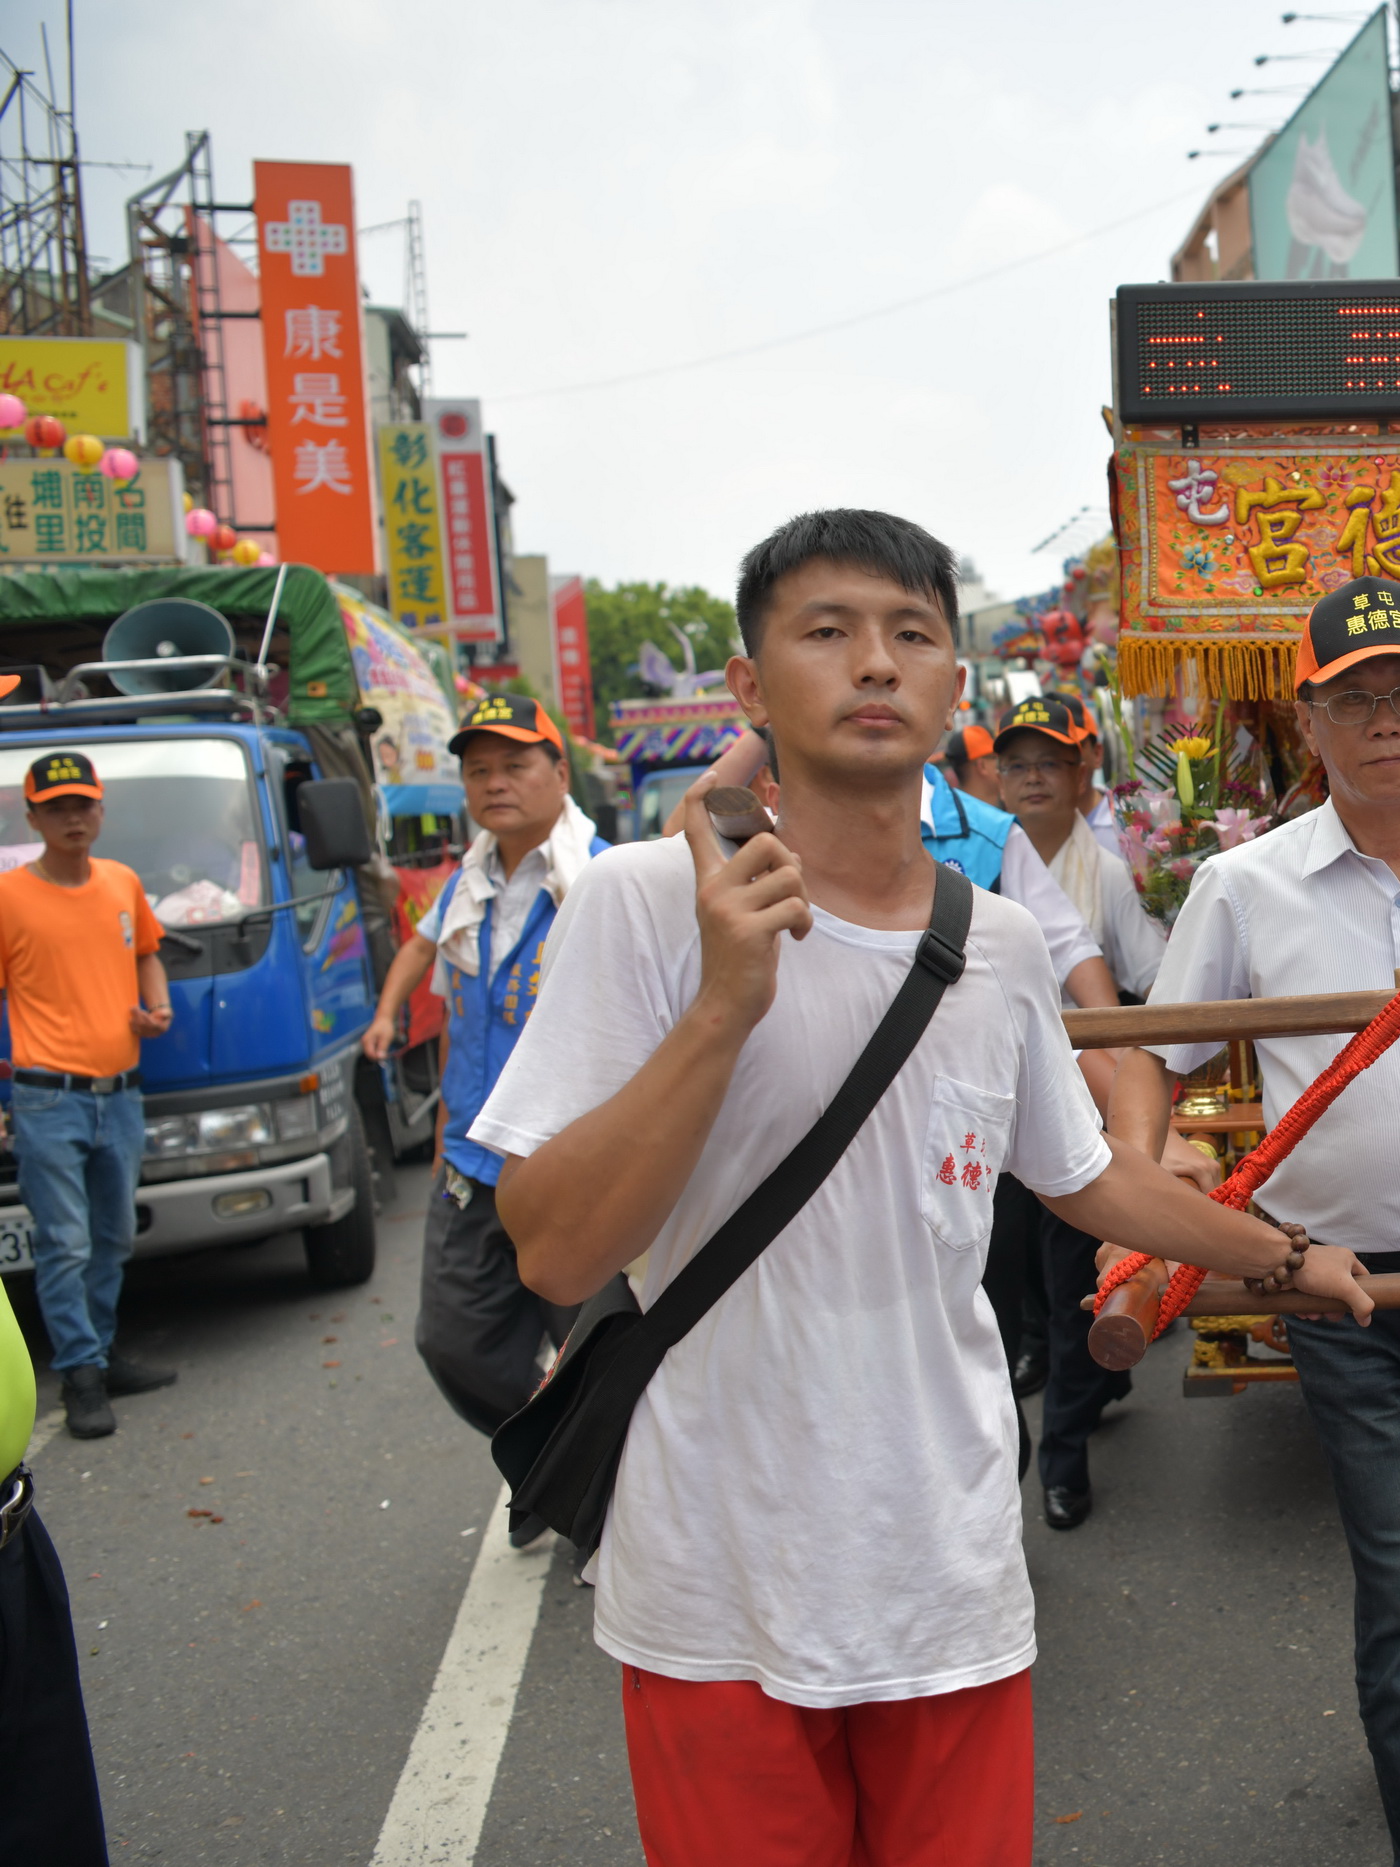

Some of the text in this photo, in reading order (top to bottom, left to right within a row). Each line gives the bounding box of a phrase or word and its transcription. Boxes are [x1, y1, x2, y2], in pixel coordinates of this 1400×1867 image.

[284, 305, 353, 495] 康是美
[72, 472, 108, 553] 南投
[389, 431, 439, 605] 彰化客運
[1168, 459, 1230, 526] 屯
[1352, 590, 1395, 611] 草屯
